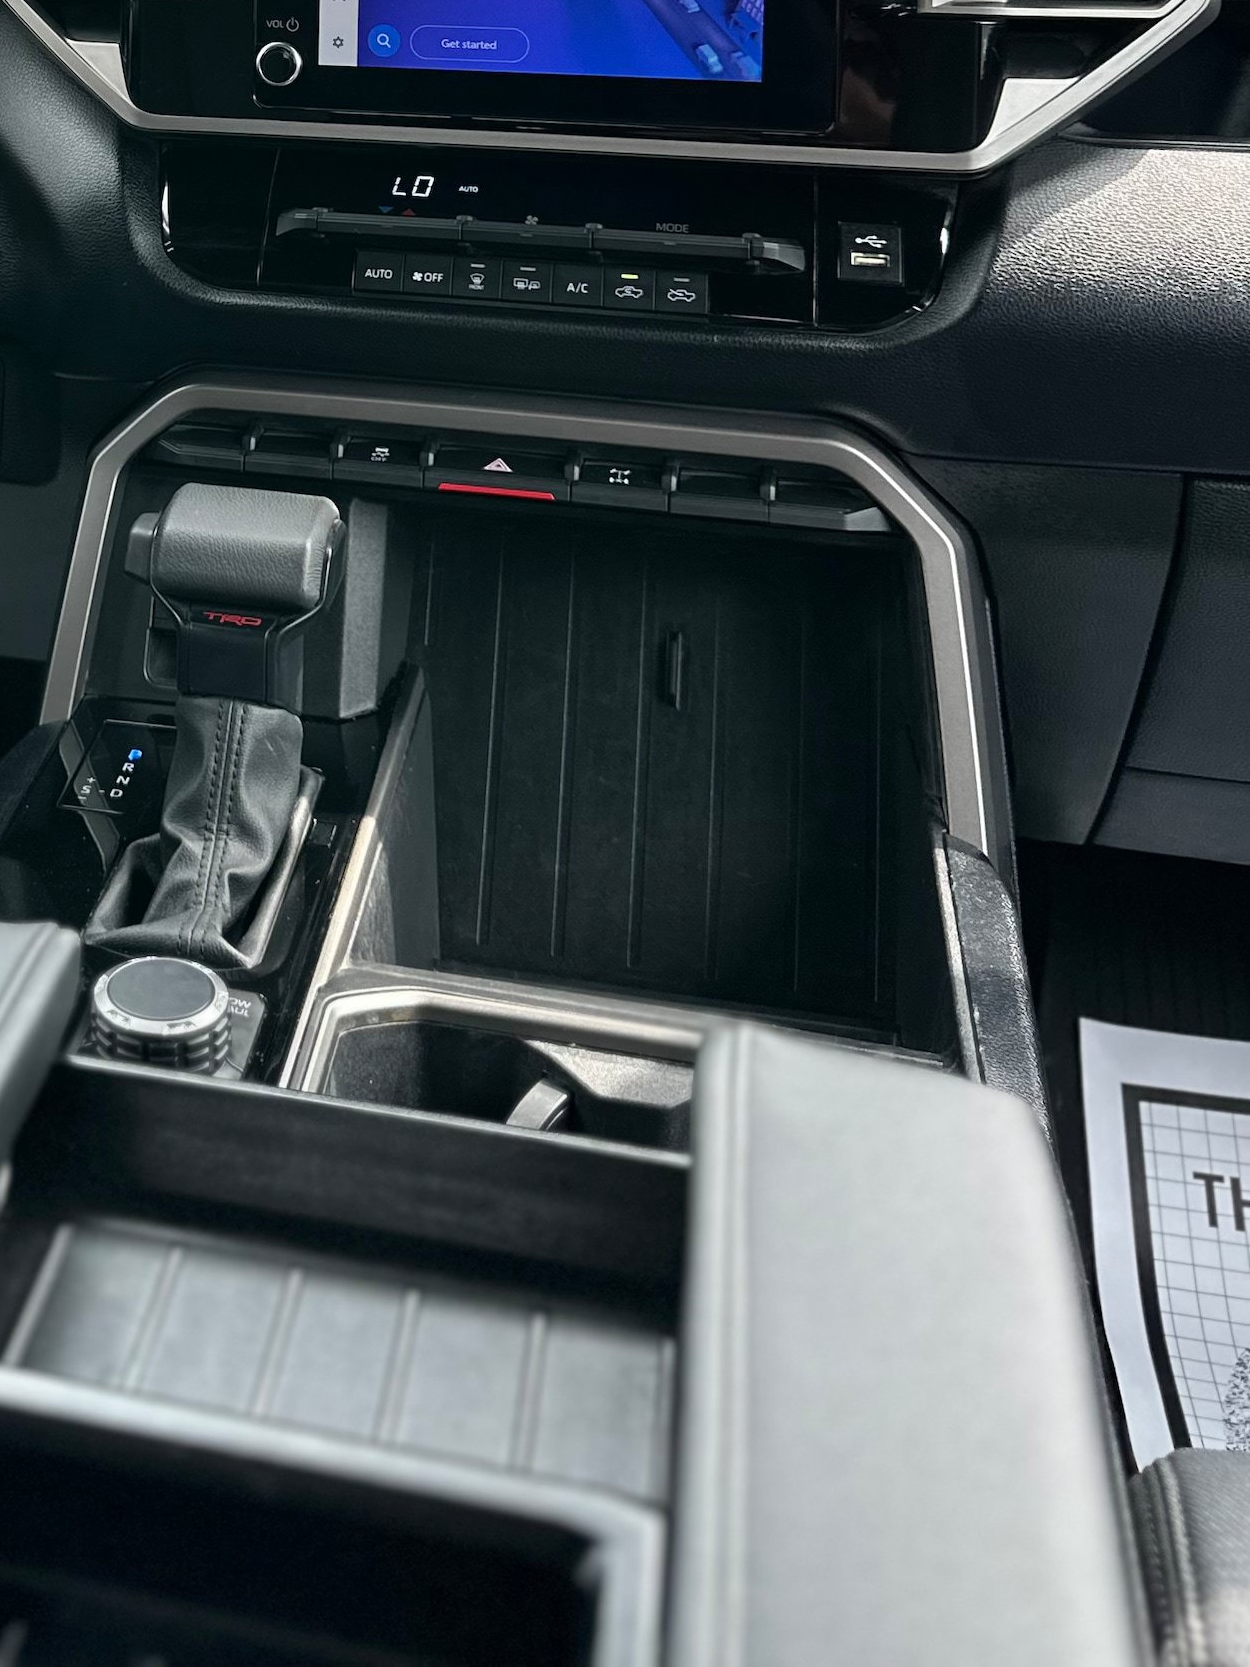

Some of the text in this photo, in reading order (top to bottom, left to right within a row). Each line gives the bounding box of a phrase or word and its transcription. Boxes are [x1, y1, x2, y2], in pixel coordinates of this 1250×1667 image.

[266, 19, 284, 28] VOL
[440, 38, 497, 50] Get started
[392, 175, 434, 197] LO
[458, 185, 479, 193] AUTO
[655, 223, 690, 234] MODE
[364, 268, 393, 279] AUTO
[424, 272, 444, 283] OFF
[566, 282, 588, 294] A/C
[202, 611, 262, 626] TRD
[122, 762, 135, 772] R
[116, 775, 130, 785] N
[80, 785, 92, 794] S
[110, 788, 123, 798] D
